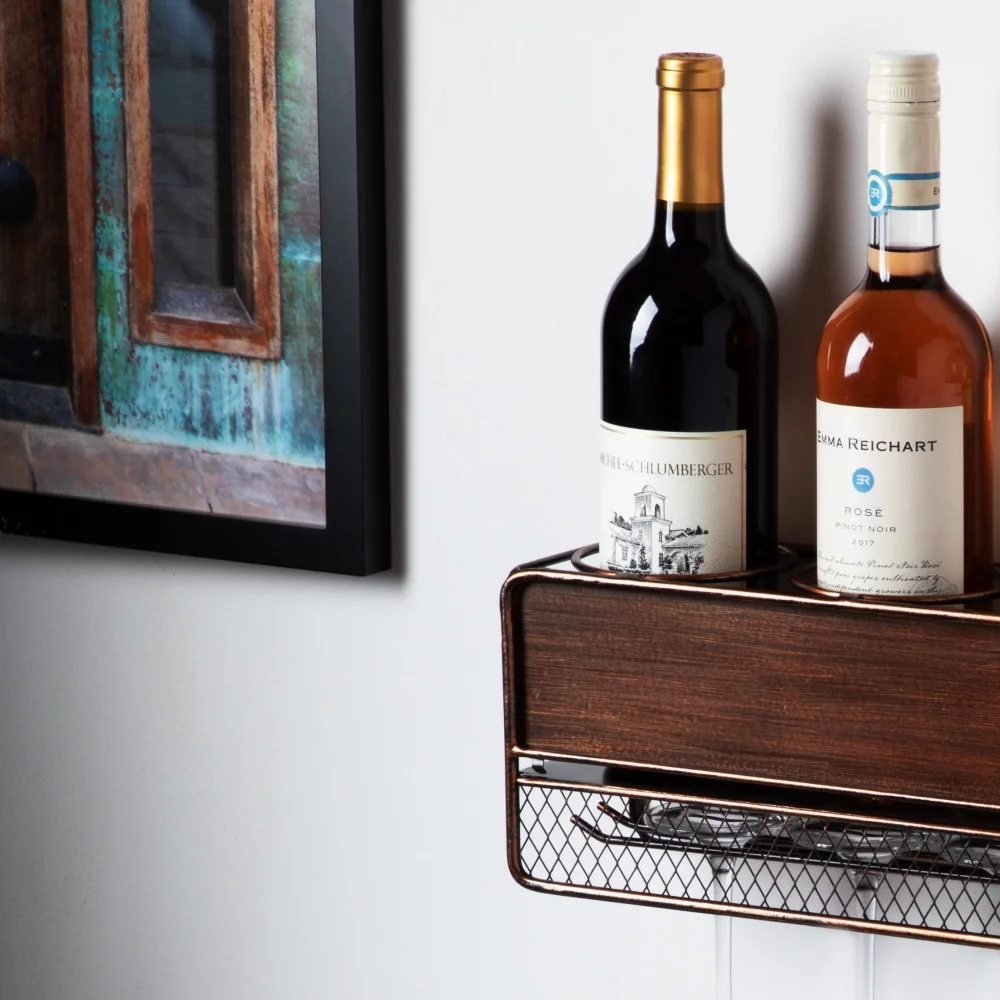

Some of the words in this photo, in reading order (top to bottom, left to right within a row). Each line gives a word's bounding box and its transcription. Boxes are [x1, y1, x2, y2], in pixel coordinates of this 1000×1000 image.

[848, 438, 937, 452] REICHART
[844, 507, 883, 518] ROSÉ
[835, 522, 863, 533] PINOT
[852, 539, 875, 547] 2017
[881, 574, 930, 582] cultivated
